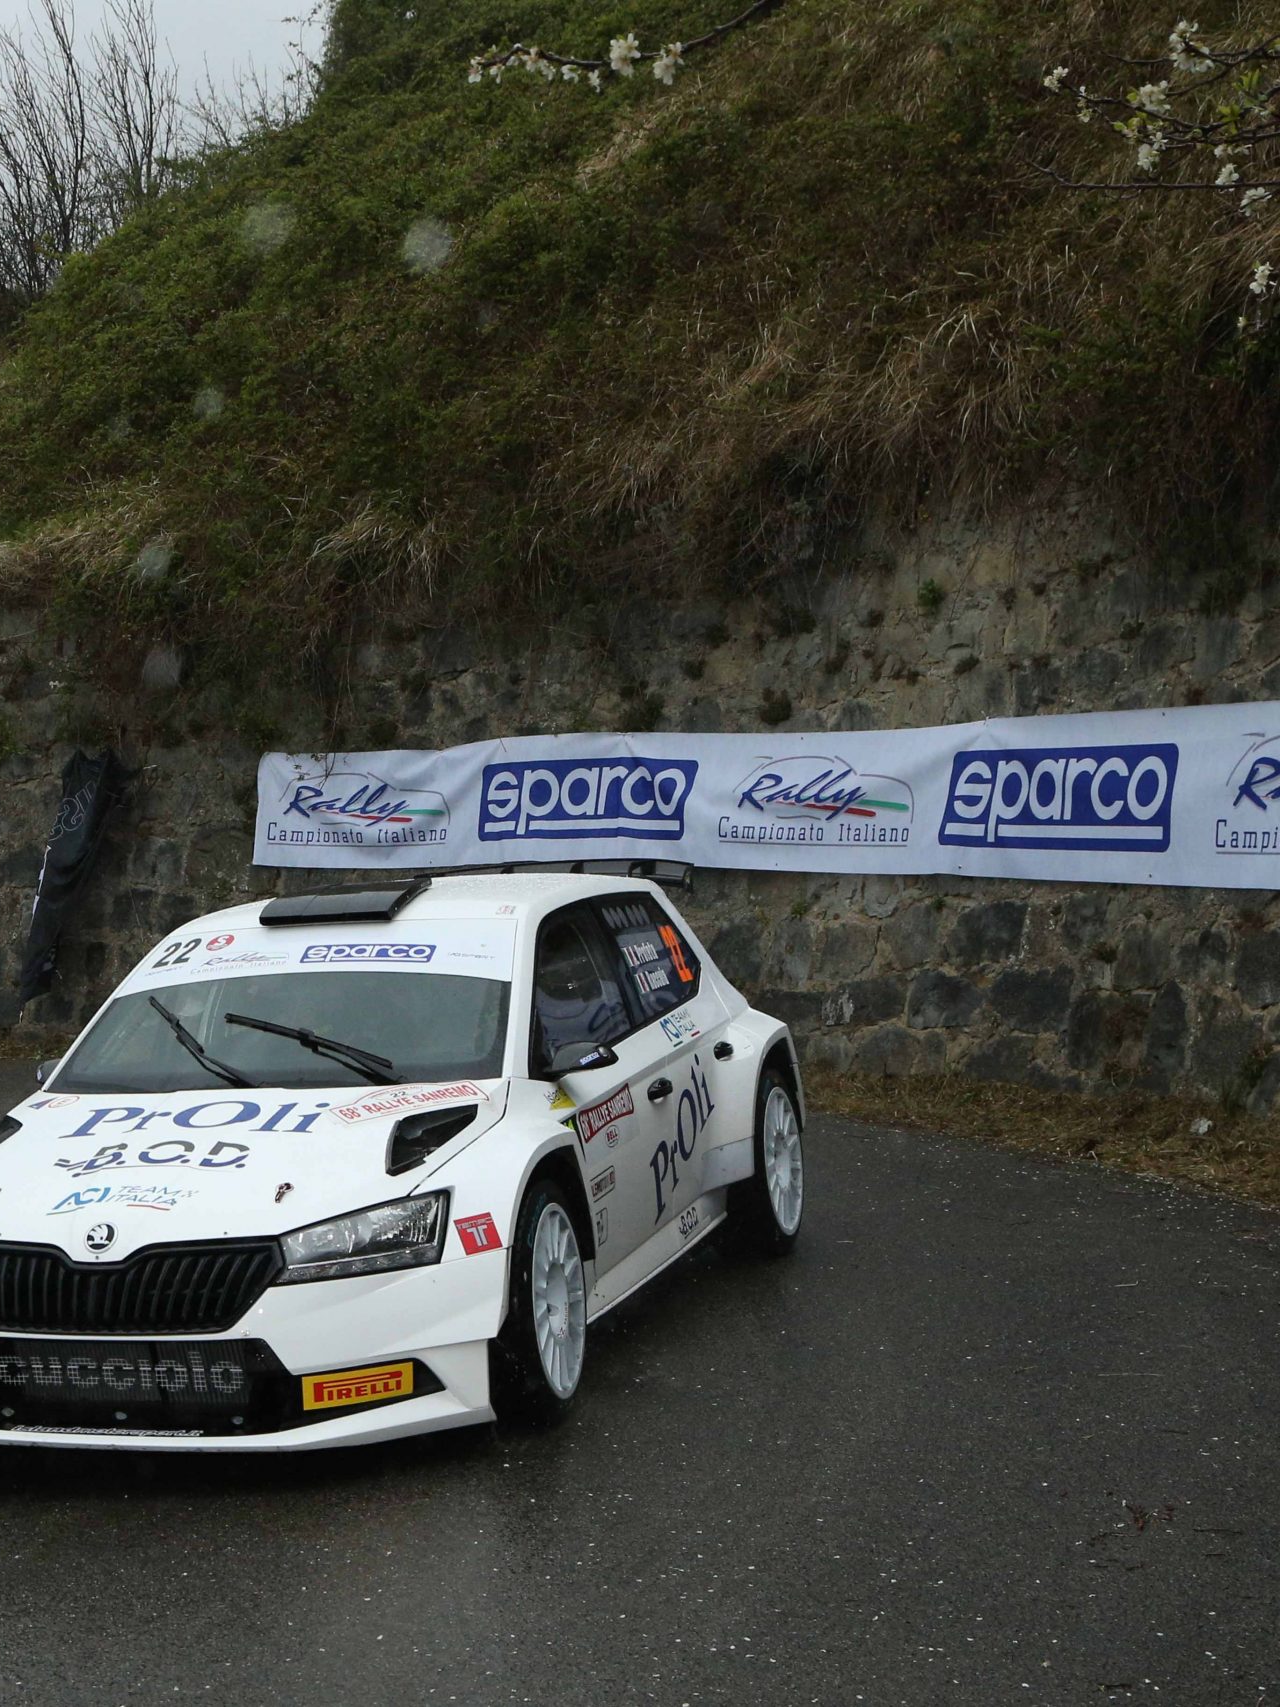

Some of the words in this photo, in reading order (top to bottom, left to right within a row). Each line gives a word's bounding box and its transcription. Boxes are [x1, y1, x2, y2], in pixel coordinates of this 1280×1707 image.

[283, 783, 410, 828] Rally
[484, 763, 687, 835] sparco
[737, 768, 867, 822] Rally
[954, 755, 1168, 843] sparco
[266, 821, 364, 846] Campionato
[376, 824, 448, 844] Italiano
[718, 817, 824, 844] Campionato
[838, 822, 910, 843] Italiano
[151, 938, 203, 969] 22
[306, 944, 432, 963] sparco
[363, 1096, 414, 1114] RALLYE
[414, 1084, 479, 1104] SANREMO
[58, 1100, 331, 1139] PrOli
[650, 1054, 715, 1225] PrOli
[52, 1187, 112, 1210] ACI
[313, 1370, 403, 1403] PIRELLI
